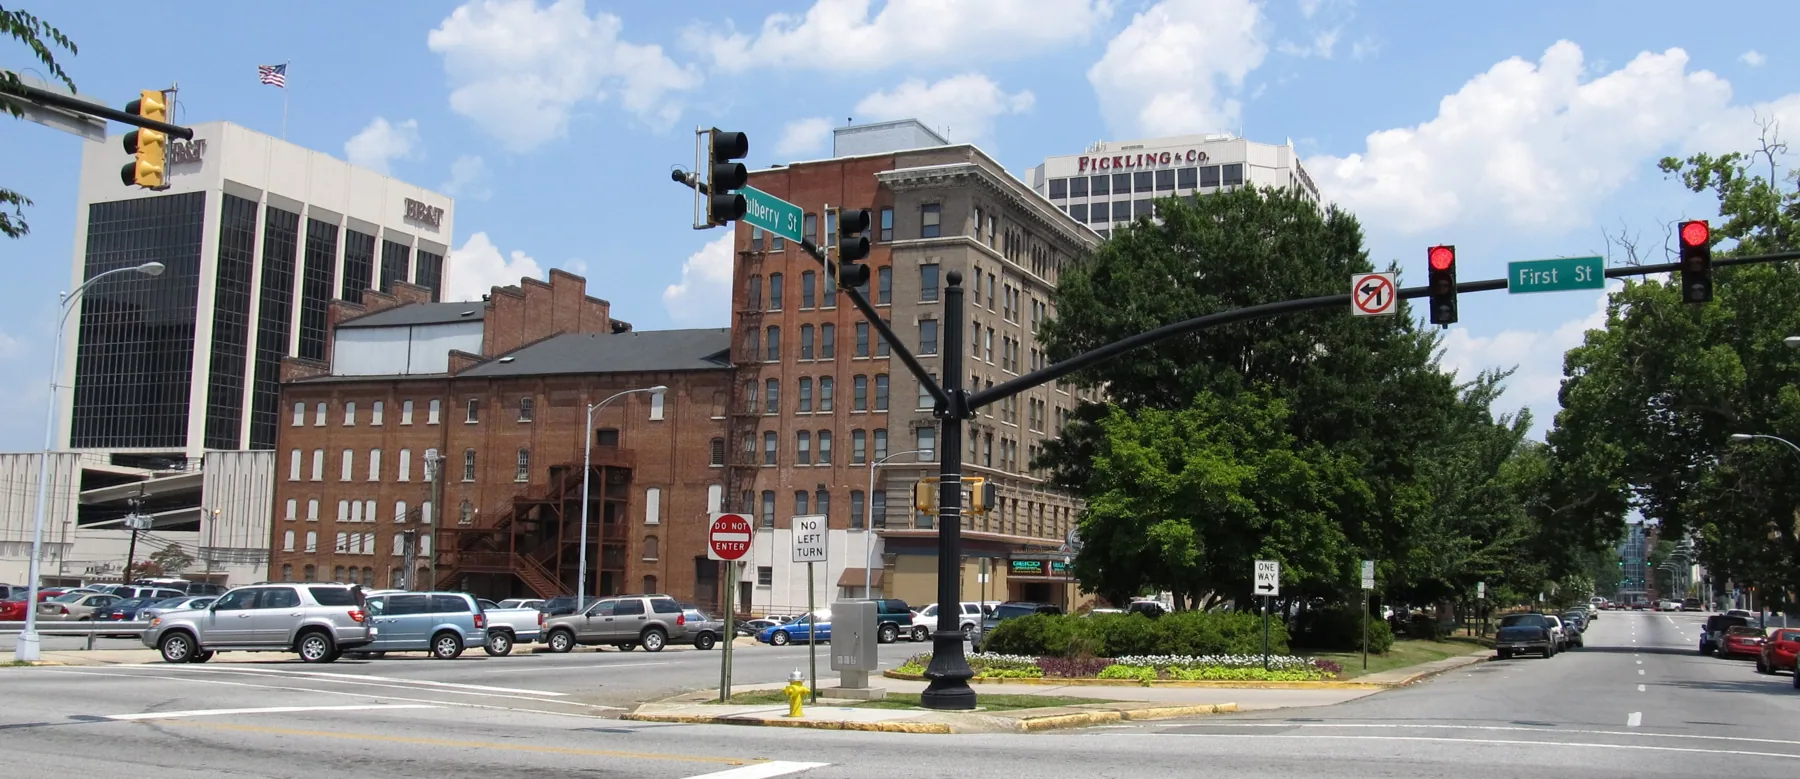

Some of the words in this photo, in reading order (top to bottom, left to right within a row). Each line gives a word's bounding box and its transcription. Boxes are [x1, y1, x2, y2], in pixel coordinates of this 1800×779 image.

[1078, 151, 1172, 173] FICKLING
[1174, 152, 1183, 161] &
[404, 197, 445, 228] BB&T
[742, 194, 780, 230] ulberry
[787, 212, 798, 233] St
[1519, 267, 1559, 286] First
[1574, 265, 1593, 283] St
[714, 522, 727, 531] DO
[731, 522, 748, 531] NOT
[800, 521, 817, 531] NO
[797, 534, 821, 544] LEFT
[715, 542, 745, 551] ENTER
[796, 547, 823, 557] TURN
[1012, 560, 1041, 568] GEICO
[1258, 562, 1275, 572] ONE
[1257, 573, 1276, 581] WAY
